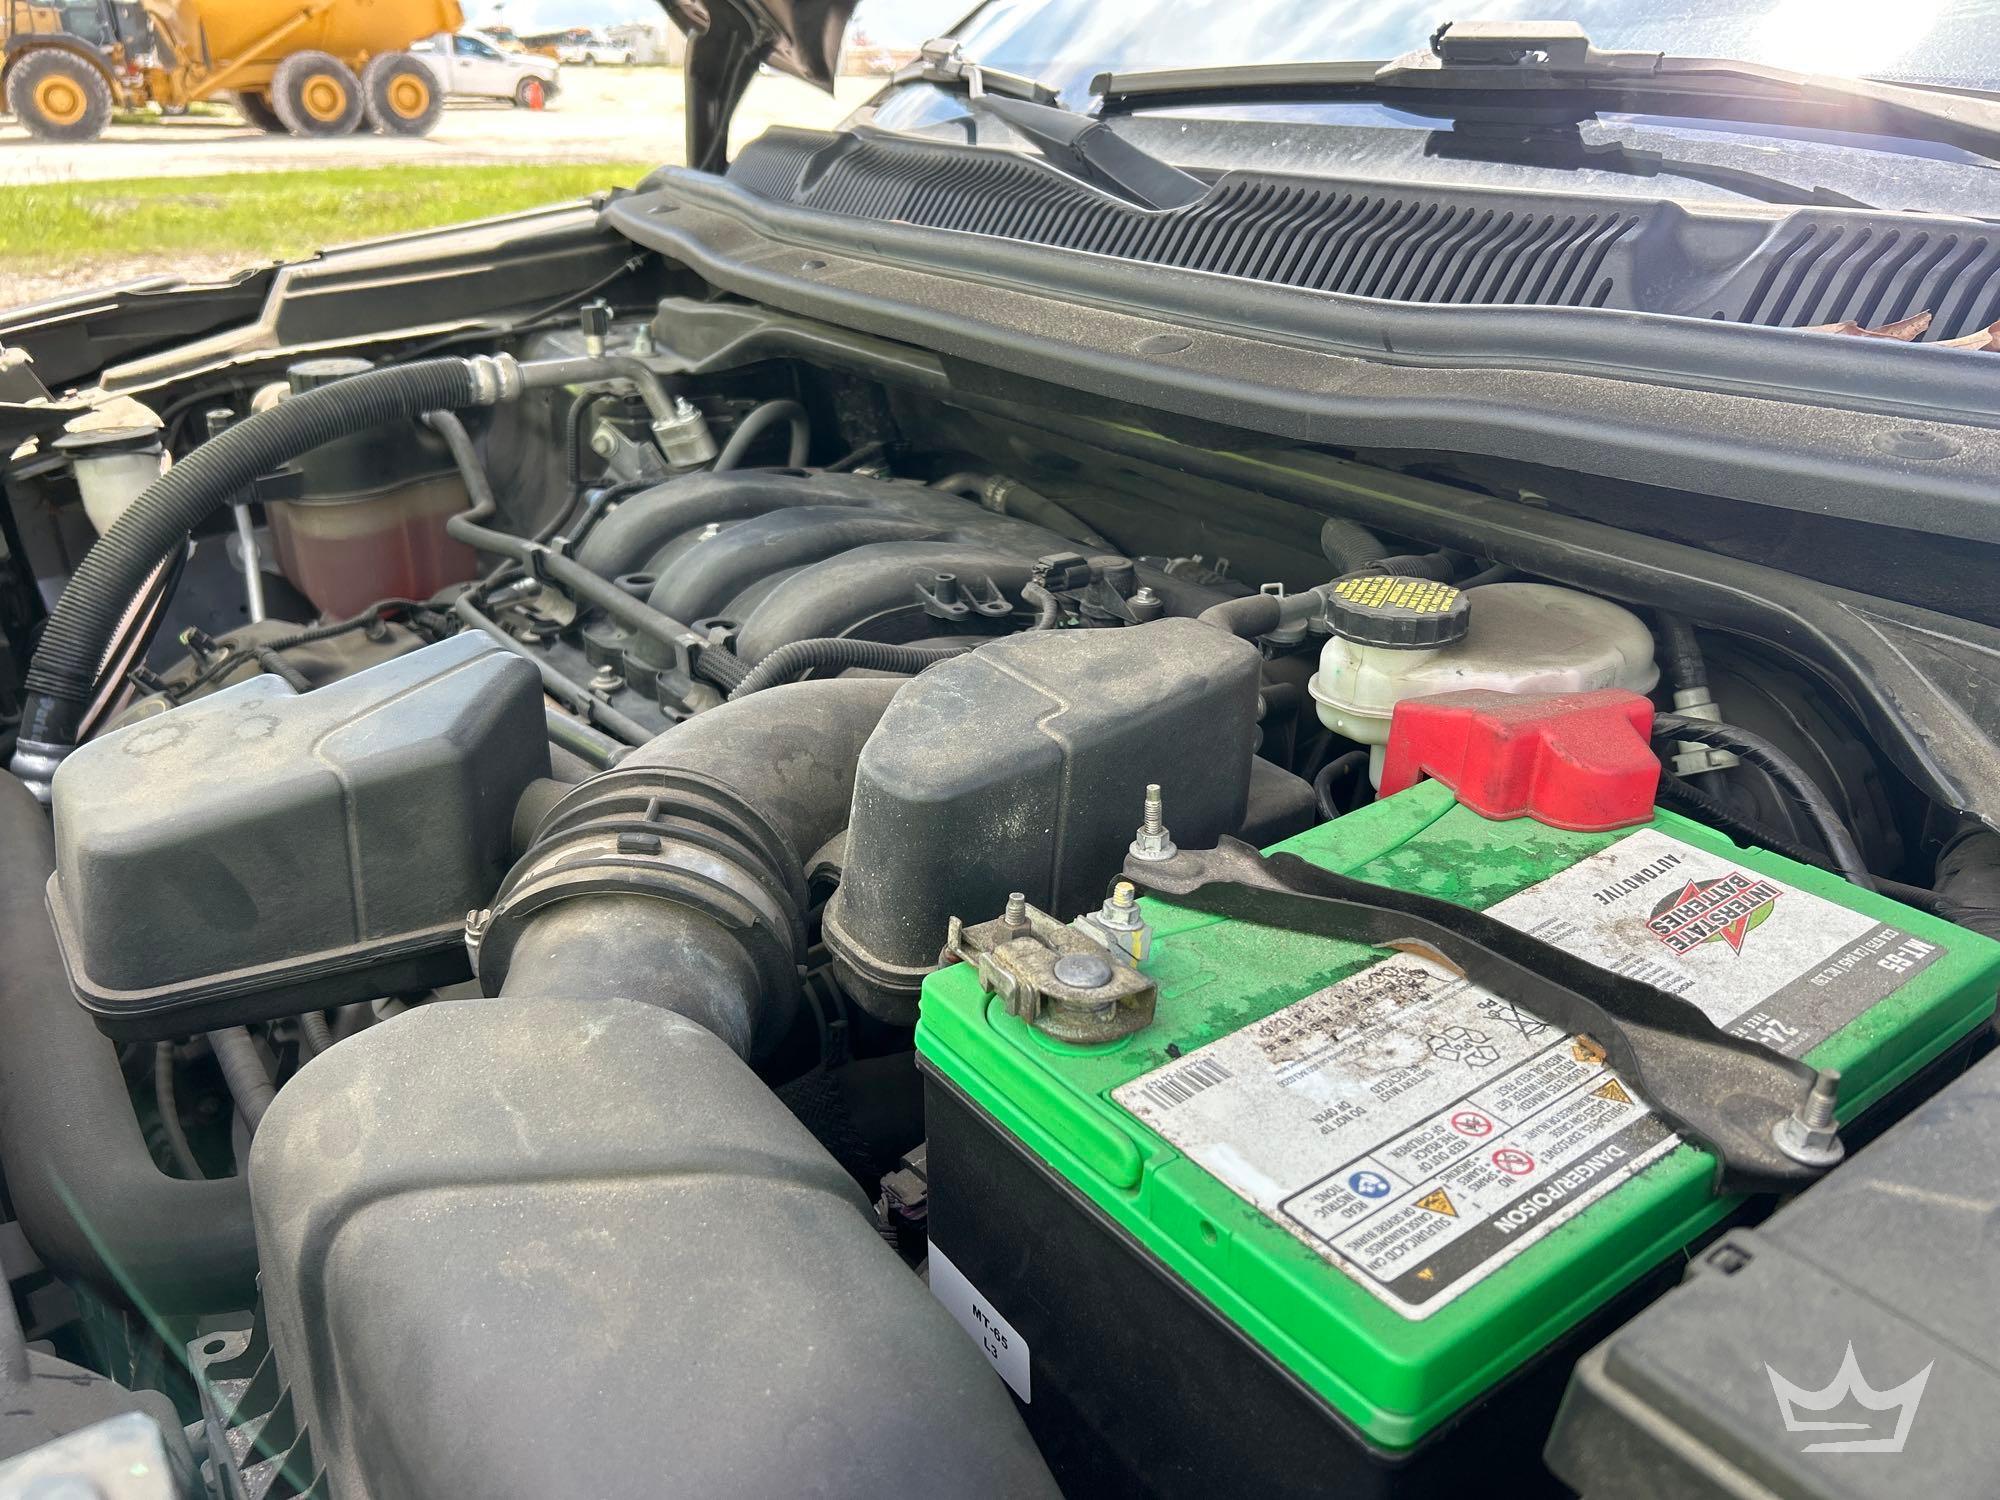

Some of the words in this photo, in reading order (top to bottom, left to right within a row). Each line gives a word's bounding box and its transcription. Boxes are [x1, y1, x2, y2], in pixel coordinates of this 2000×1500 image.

[1593, 854, 1682, 904] AUTOMOTIVE
[1651, 875, 1752, 935] BATTERIES
[1666, 884, 1778, 951] INTERSTATE
[1876, 928, 1900, 940] CCA
[1850, 947, 1870, 957] CA
[1877, 939, 1936, 973] MT-65
[1822, 966, 1843, 977] RC
[1477, 998, 1498, 1009] Pb
[1741, 1012, 1771, 1029] FREE
[1453, 1040, 1473, 1052] Pb
[1527, 1053, 1566, 1076] MEDICAL
[1552, 1059, 1578, 1075] ATELY
[1368, 1069, 1410, 1093] RECYCLED
[1396, 1068, 1434, 1090] BATTERY
[1511, 1071, 1535, 1086] HELP
[1561, 1066, 1589, 1083] FLUSH
[1375, 1086, 1402, 1102] MUST
[1544, 1079, 1567, 1094] EYES
[1333, 1100, 1351, 1111] OR
[1347, 1105, 1366, 1117] DO
[1493, 1098, 1513, 1111] GET
[1581, 1099, 1610, 1117] GASES
[1597, 1102, 1629, 1123] SHIELD
[1330, 1113, 1353, 1127] NOT
[1545, 1115, 1561, 1125] OR
[1568, 1113, 1588, 1126] CAN
[1316, 1123, 1336, 1135] TIP
[1428, 1124, 1446, 1135] OF
[1435, 1130, 1458, 1145] THE
[1548, 1121, 1575, 1138] CAUSE
[1409, 1140, 1442, 1161] REACH
[1444, 1138, 1470, 1155] KEEP
[1540, 1130, 1586, 1160] EXPLOSIVE
[1415, 1161, 1433, 1172] OF
[1427, 1151, 1450, 1165] OUT
[1438, 1158, 1476, 1182] SMOKING
[1455, 1164, 1487, 1185] FLAMES
[1466, 1171, 1499, 1192] SPARKS
[1491, 1143, 1626, 1234] DANGER/POISON
[1496, 1174, 1516, 1188] NO
[1339, 1199, 1368, 1218] READ
[1399, 1206, 1416, 1217] OR
[1372, 1212, 1405, 1234] SEVERE
[1404, 1211, 1433, 1230] CAUSE
[1403, 1216, 1451, 1248] SULFURIC
[1363, 1226, 1410, 1256] BLINDNESS
[1382, 1241, 1412, 1261] ACID
[1365, 1256, 1387, 1271] CAN
[973, 1304, 1008, 1350] MT-65
[984, 1336, 998, 1359] L3
